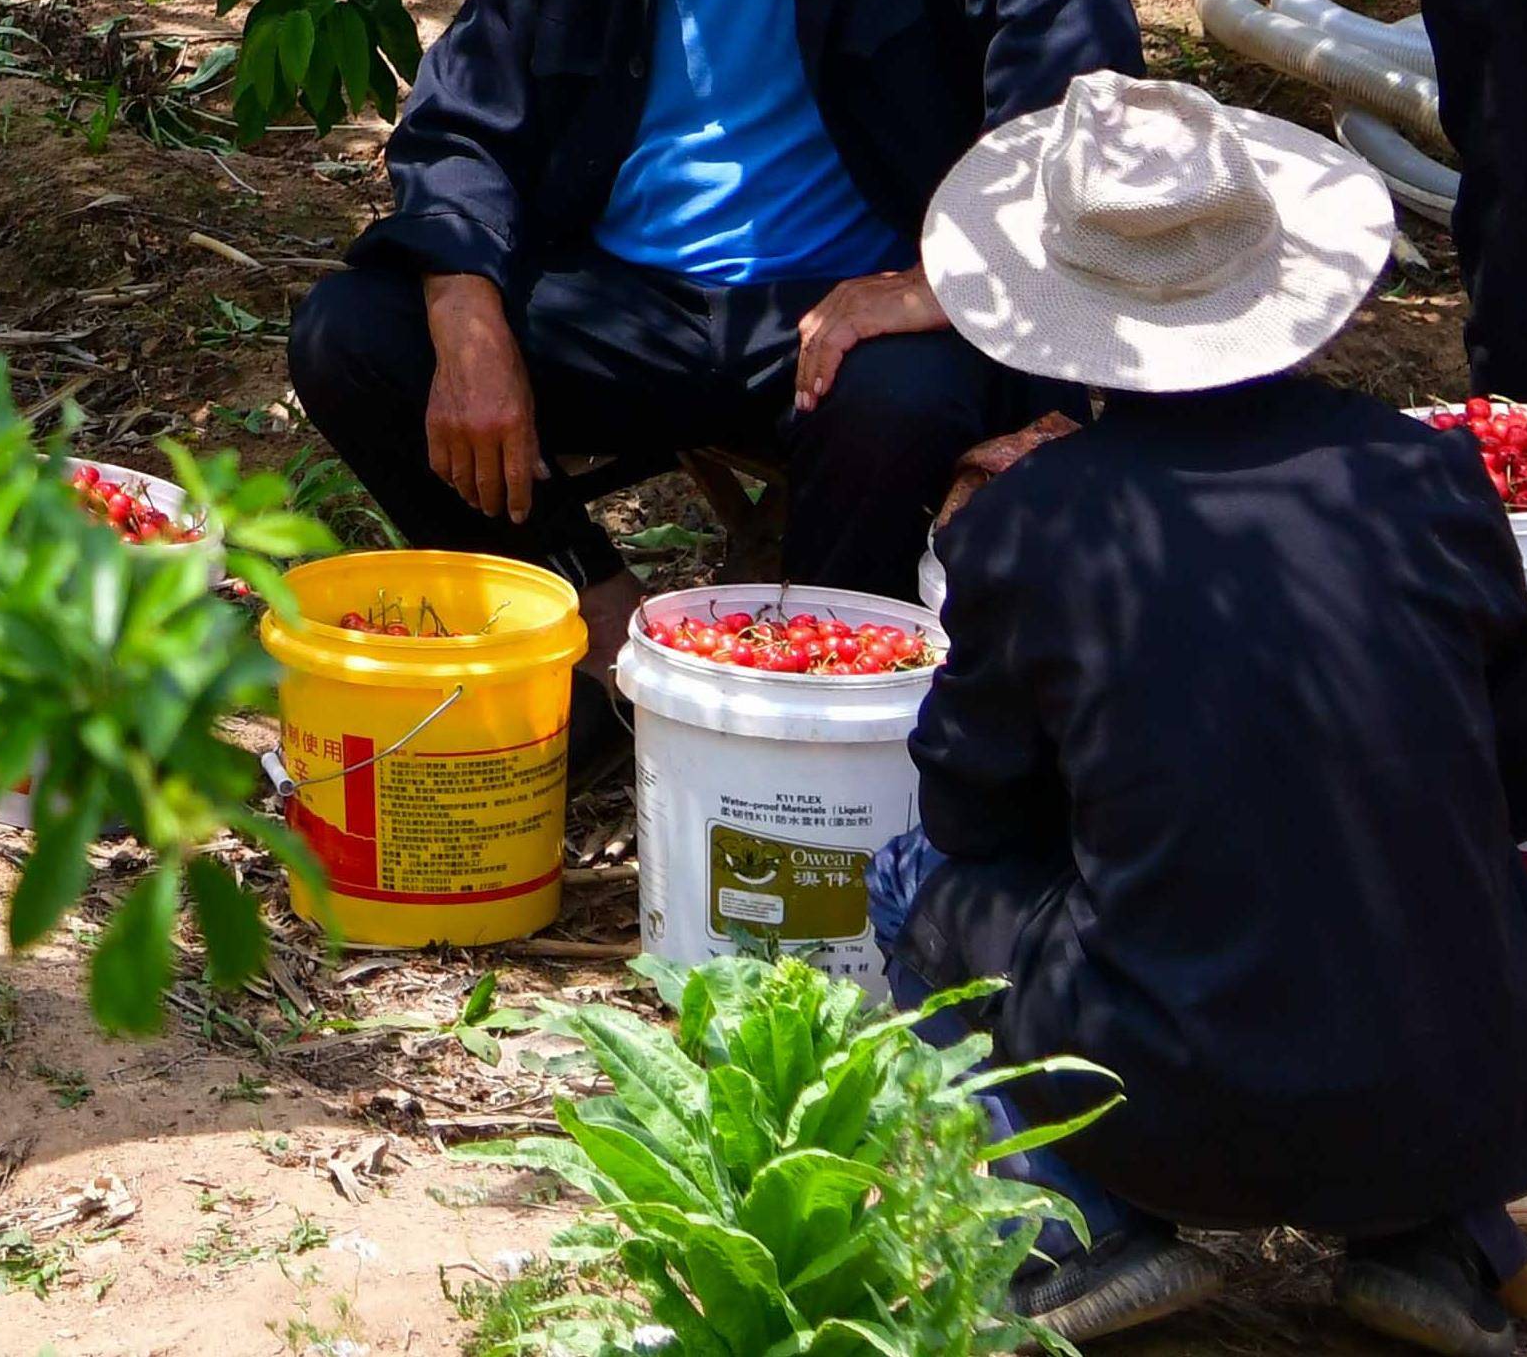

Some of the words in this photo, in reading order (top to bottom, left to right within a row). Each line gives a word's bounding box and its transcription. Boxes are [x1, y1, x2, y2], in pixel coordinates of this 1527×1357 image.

[720, 795, 780, 813] Water-proof
[781, 805, 826, 815] Materials
[776, 793, 795, 803] K11
[797, 794, 822, 804] FLEX
[790, 848, 856, 867] Owear
